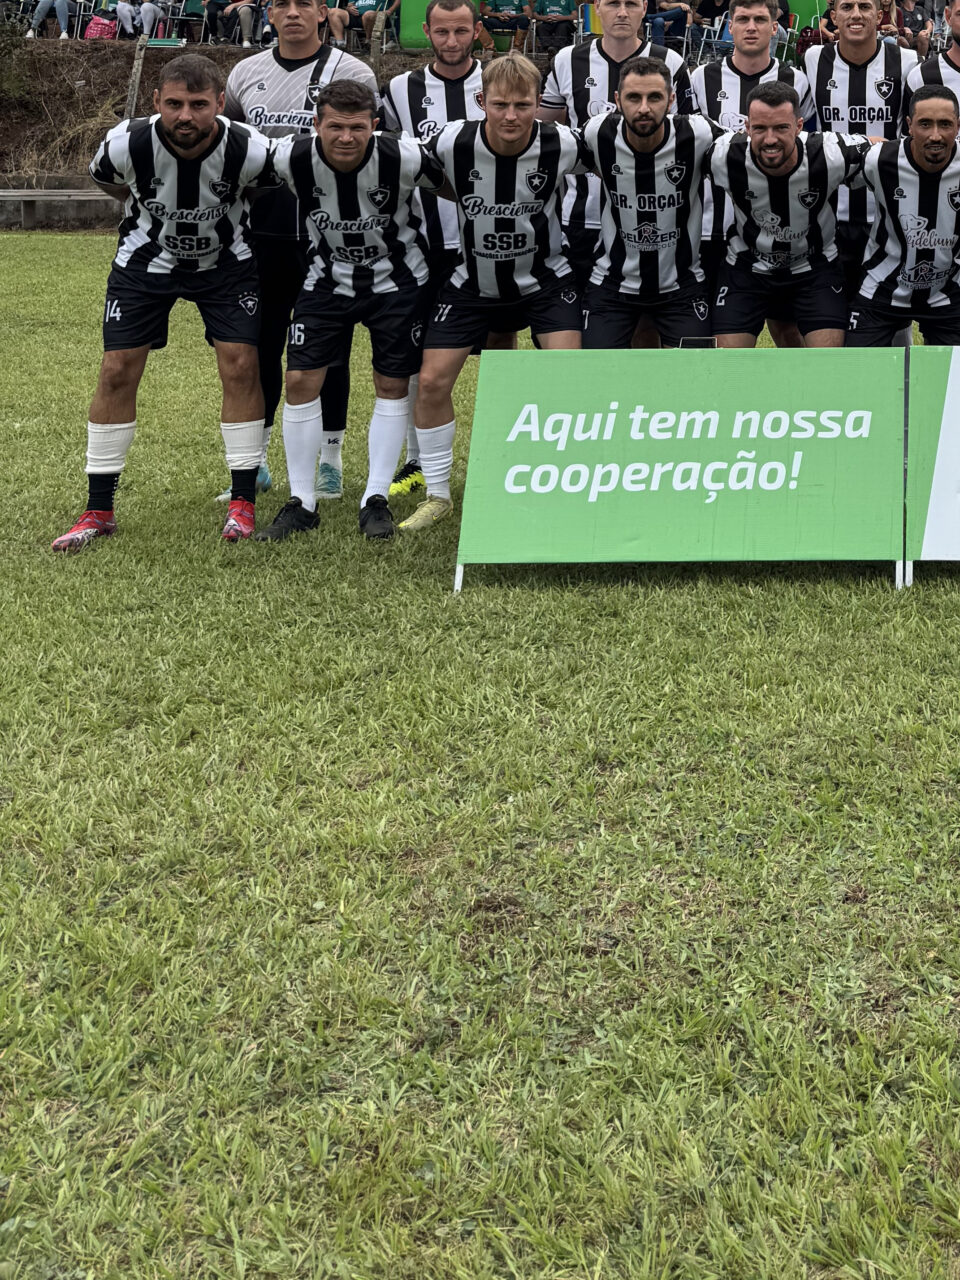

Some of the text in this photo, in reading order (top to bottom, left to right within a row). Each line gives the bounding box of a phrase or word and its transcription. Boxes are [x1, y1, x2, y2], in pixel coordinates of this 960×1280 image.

[250, 107, 313, 129] Bresciens
[823, 106, 892, 124] DR. ORÇAL
[145, 199, 231, 222] Bresciense
[463, 195, 544, 219] Bresciense
[610, 190, 684, 212] DR. ORÇAL
[164, 235, 212, 252] SSB
[482, 233, 528, 251] SSB
[620, 228, 681, 244] DELAZERI
[335, 246, 380, 264] SSB
[716, 286, 729, 306] 2
[105, 299, 122, 323] 14
[849, 311, 860, 330] 5
[290, 323, 305, 345] 16
[506, 401, 873, 451] Aqui tem nossa
[504, 450, 803, 504] cooperação!
